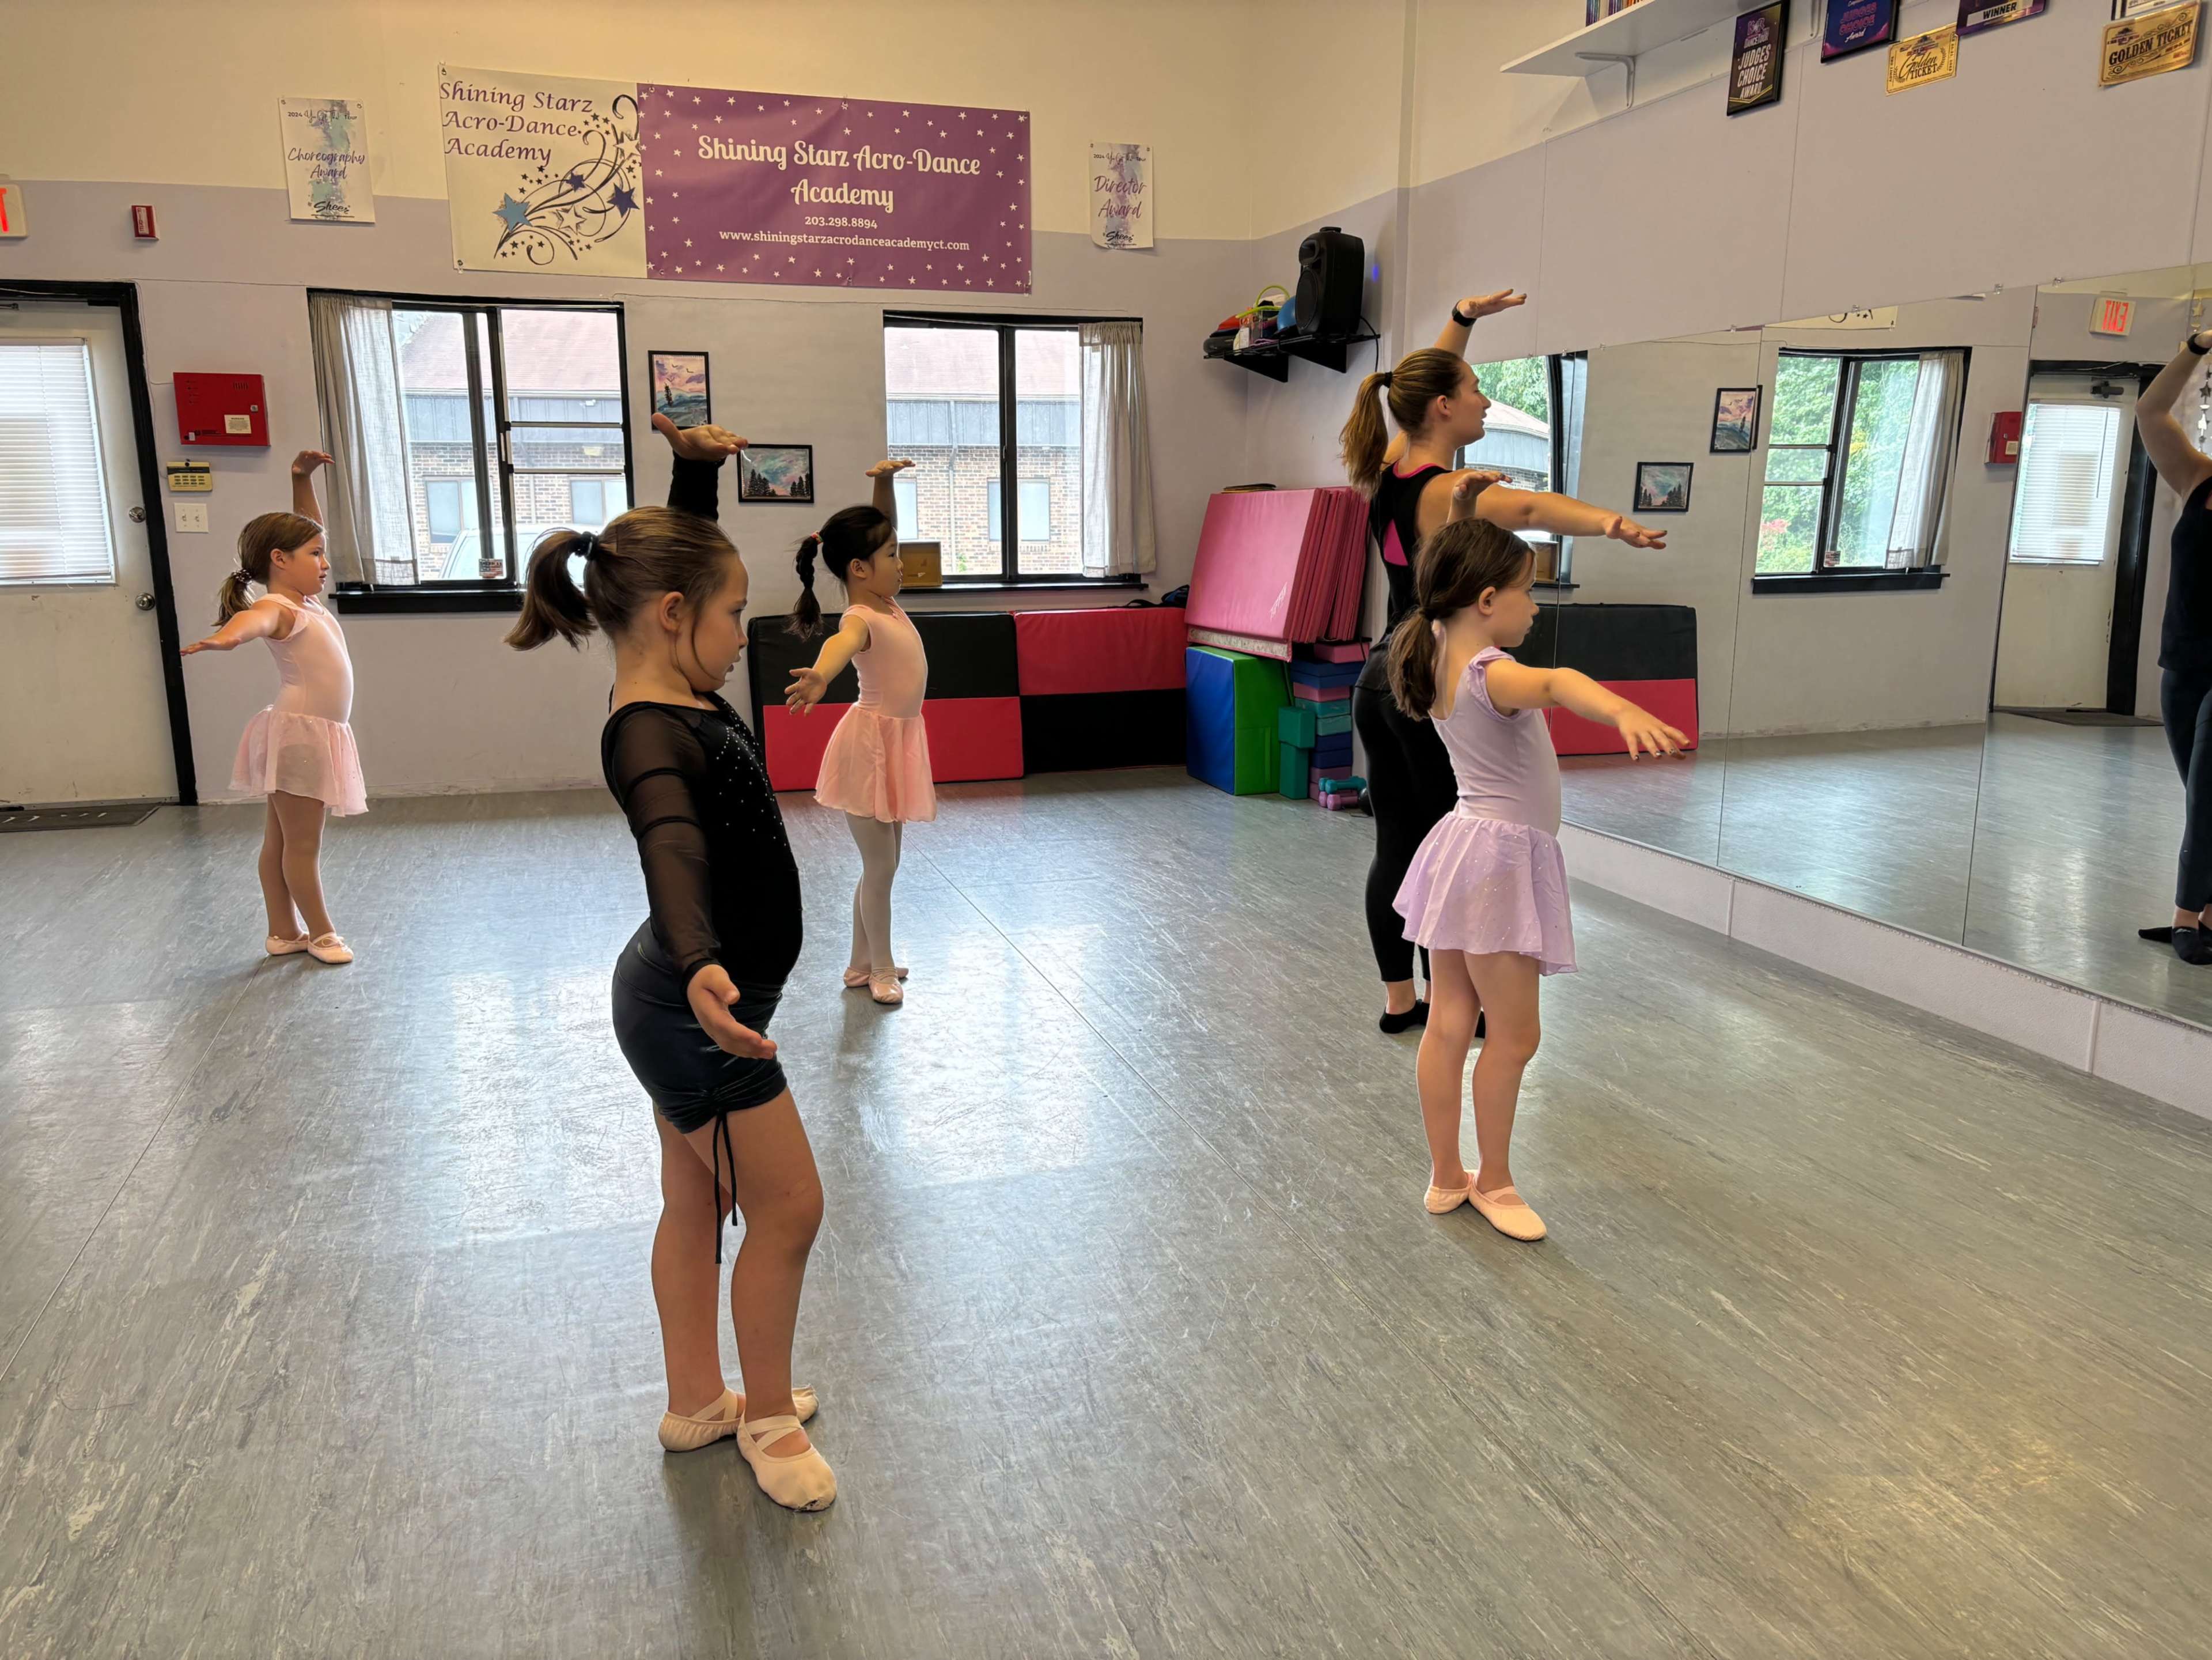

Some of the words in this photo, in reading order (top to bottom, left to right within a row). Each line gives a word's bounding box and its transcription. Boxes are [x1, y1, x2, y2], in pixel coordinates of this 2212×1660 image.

[1983, 2, 2017, 20] WINNER
[2109, 37, 2154, 66] GOLDEN
[2157, 19, 2194, 47] TICKET
[1738, 44, 1771, 70] JUDGES
[1899, 51, 1937, 81] Golden
[1737, 62, 1768, 88] CHOICE
[1911, 63, 1938, 80] TICKET
[440, 81, 525, 112] Shining
[533, 92, 593, 113] Starz
[1740, 82, 1763, 99] AWARD
[442, 111, 577, 137] Acro-Dance
[288, 148, 365, 166] Choreography
[445, 138, 552, 168] Academy
[698, 135, 787, 171] Shining
[793, 140, 850, 168] Starz
[853, 145, 981, 175] Acro-Dance
[310, 164, 347, 180] Award
[790, 179, 894, 214] Academy
[1094, 175, 1147, 195] Director
[1098, 198, 1142, 219] Award
[805, 215, 878, 230] 203.298.8894
[719, 230, 970, 251] www.shiningstarzacrodanceacademyct.com
